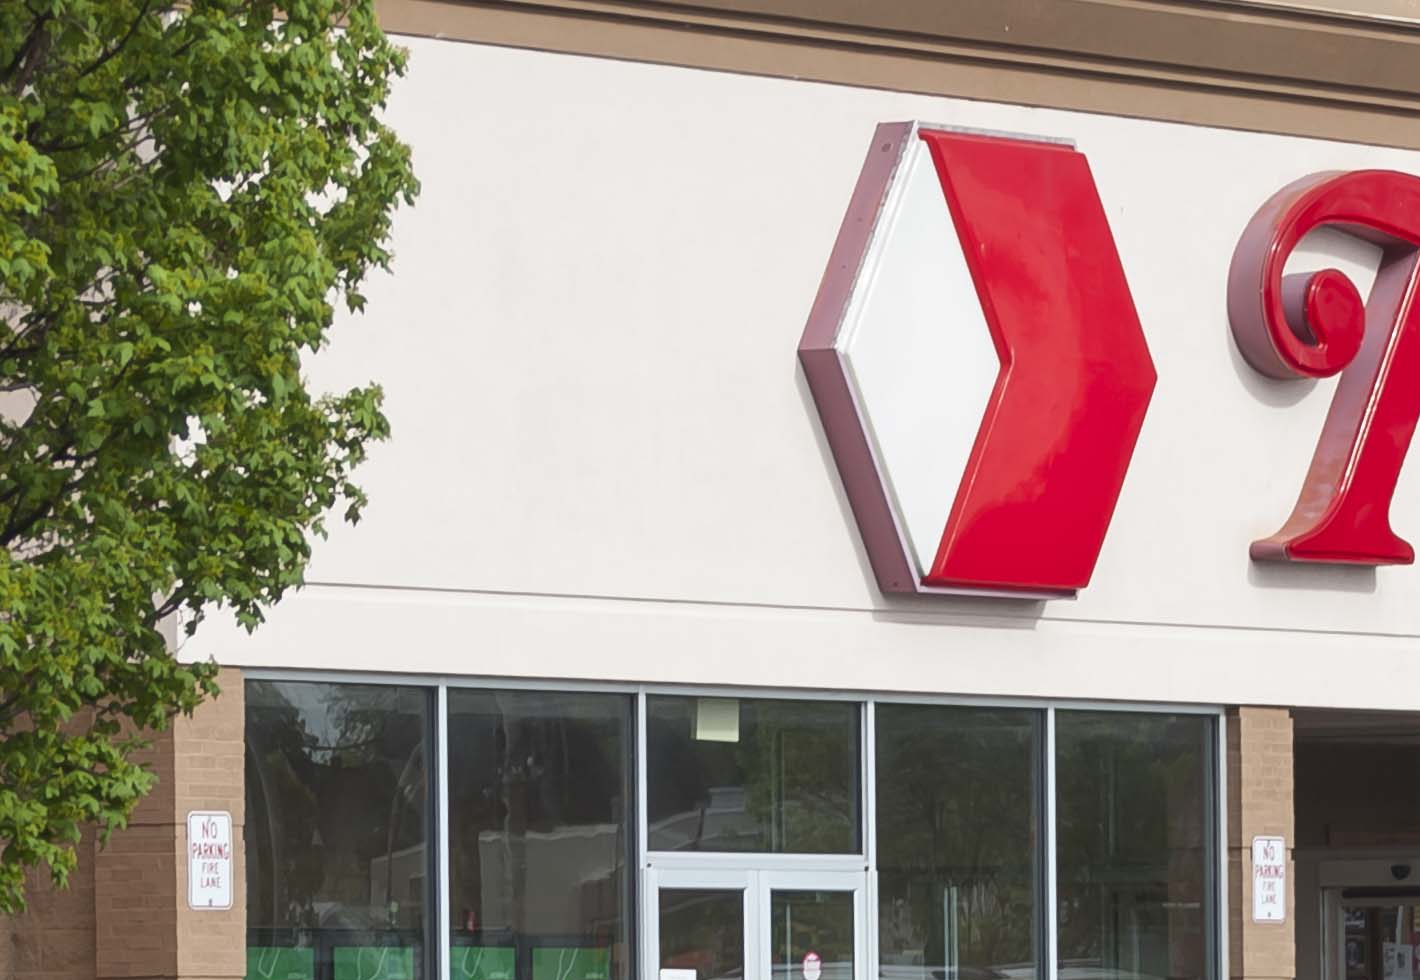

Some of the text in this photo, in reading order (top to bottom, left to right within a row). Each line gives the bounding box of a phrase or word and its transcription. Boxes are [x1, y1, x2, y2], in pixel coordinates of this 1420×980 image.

[202, 822, 218, 839] NO
[192, 842, 230, 860] PARKING
[1263, 846, 1275, 861] NO
[1255, 864, 1284, 879] PARKING
[200, 876, 222, 889] LANE
